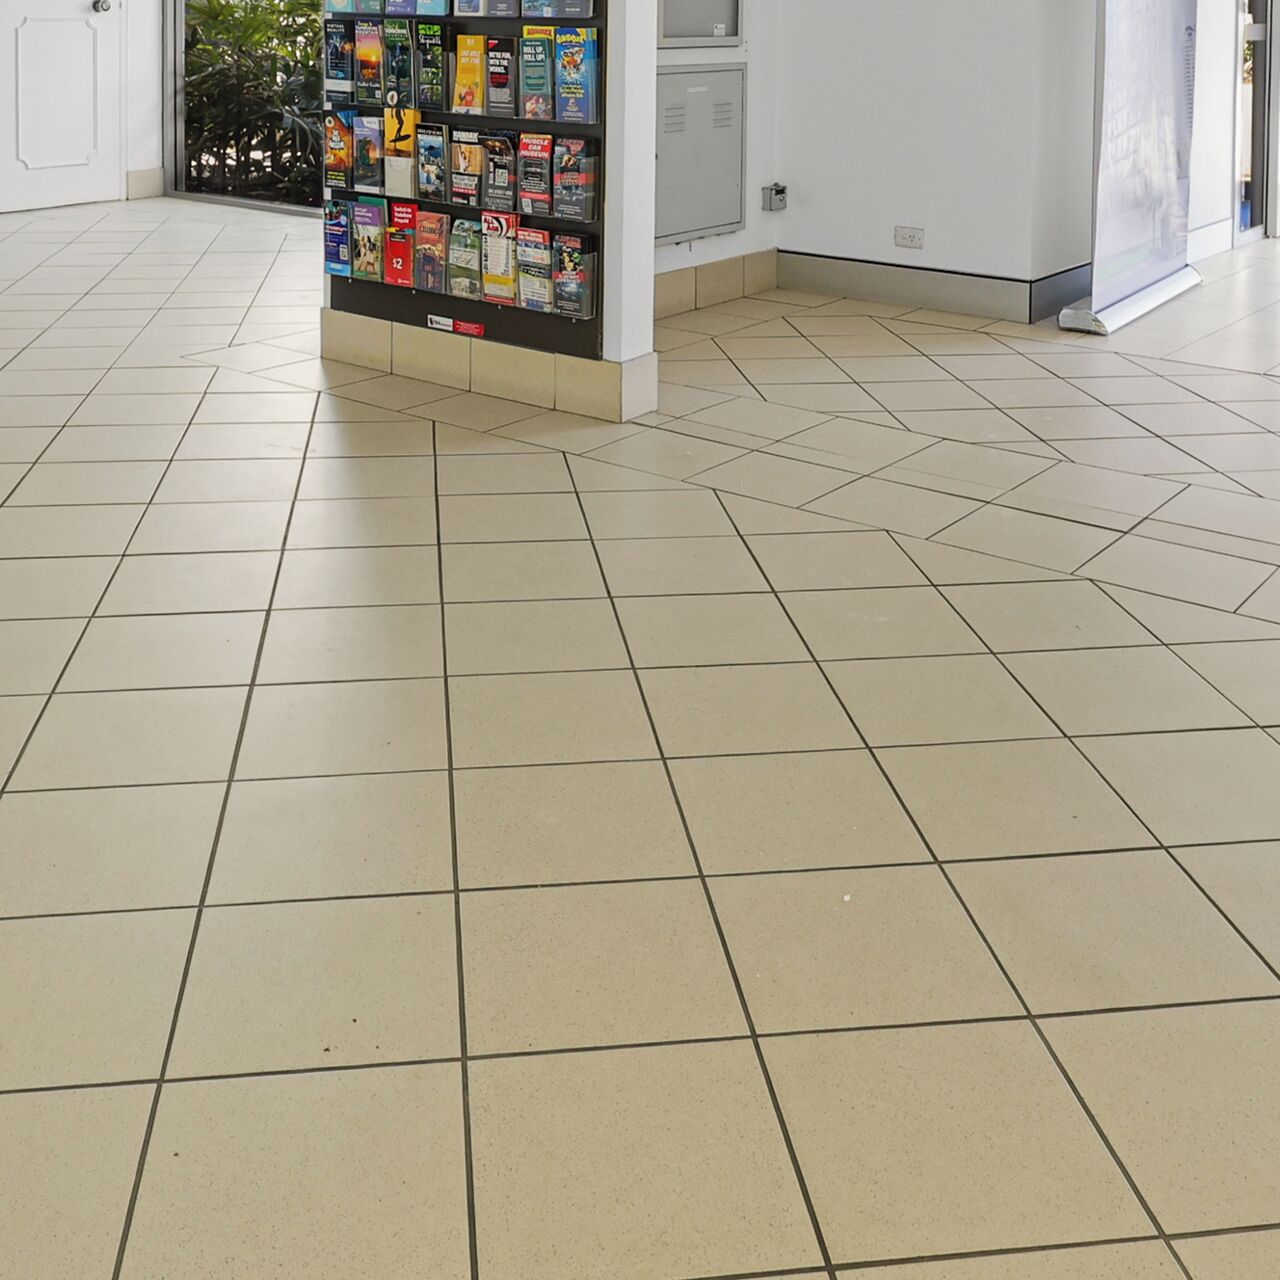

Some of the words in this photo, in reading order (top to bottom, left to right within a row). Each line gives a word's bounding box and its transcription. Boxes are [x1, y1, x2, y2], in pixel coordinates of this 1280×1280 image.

[522, 138, 549, 146] MUSCLE
[520, 150, 549, 158] MUSEUM
[392, 257, 403, 270] $2
